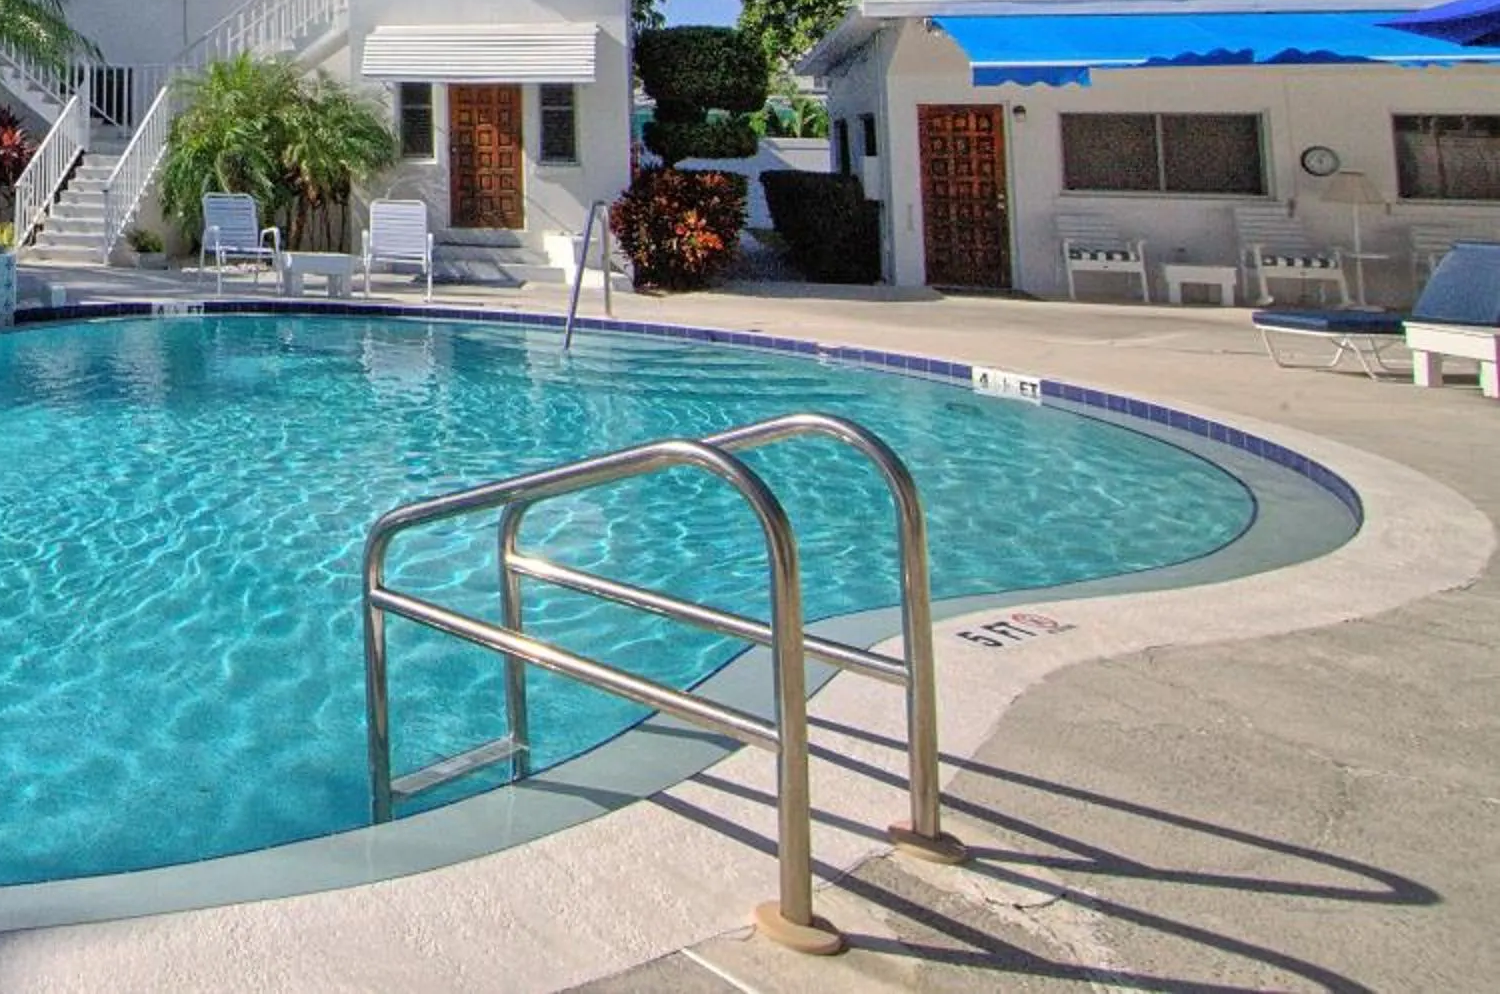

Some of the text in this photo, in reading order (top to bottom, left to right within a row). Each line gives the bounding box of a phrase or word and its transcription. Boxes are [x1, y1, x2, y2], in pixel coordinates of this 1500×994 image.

[1019, 381, 1037, 399] FT
[956, 631, 1004, 648] 5
[980, 621, 1037, 641] FT
